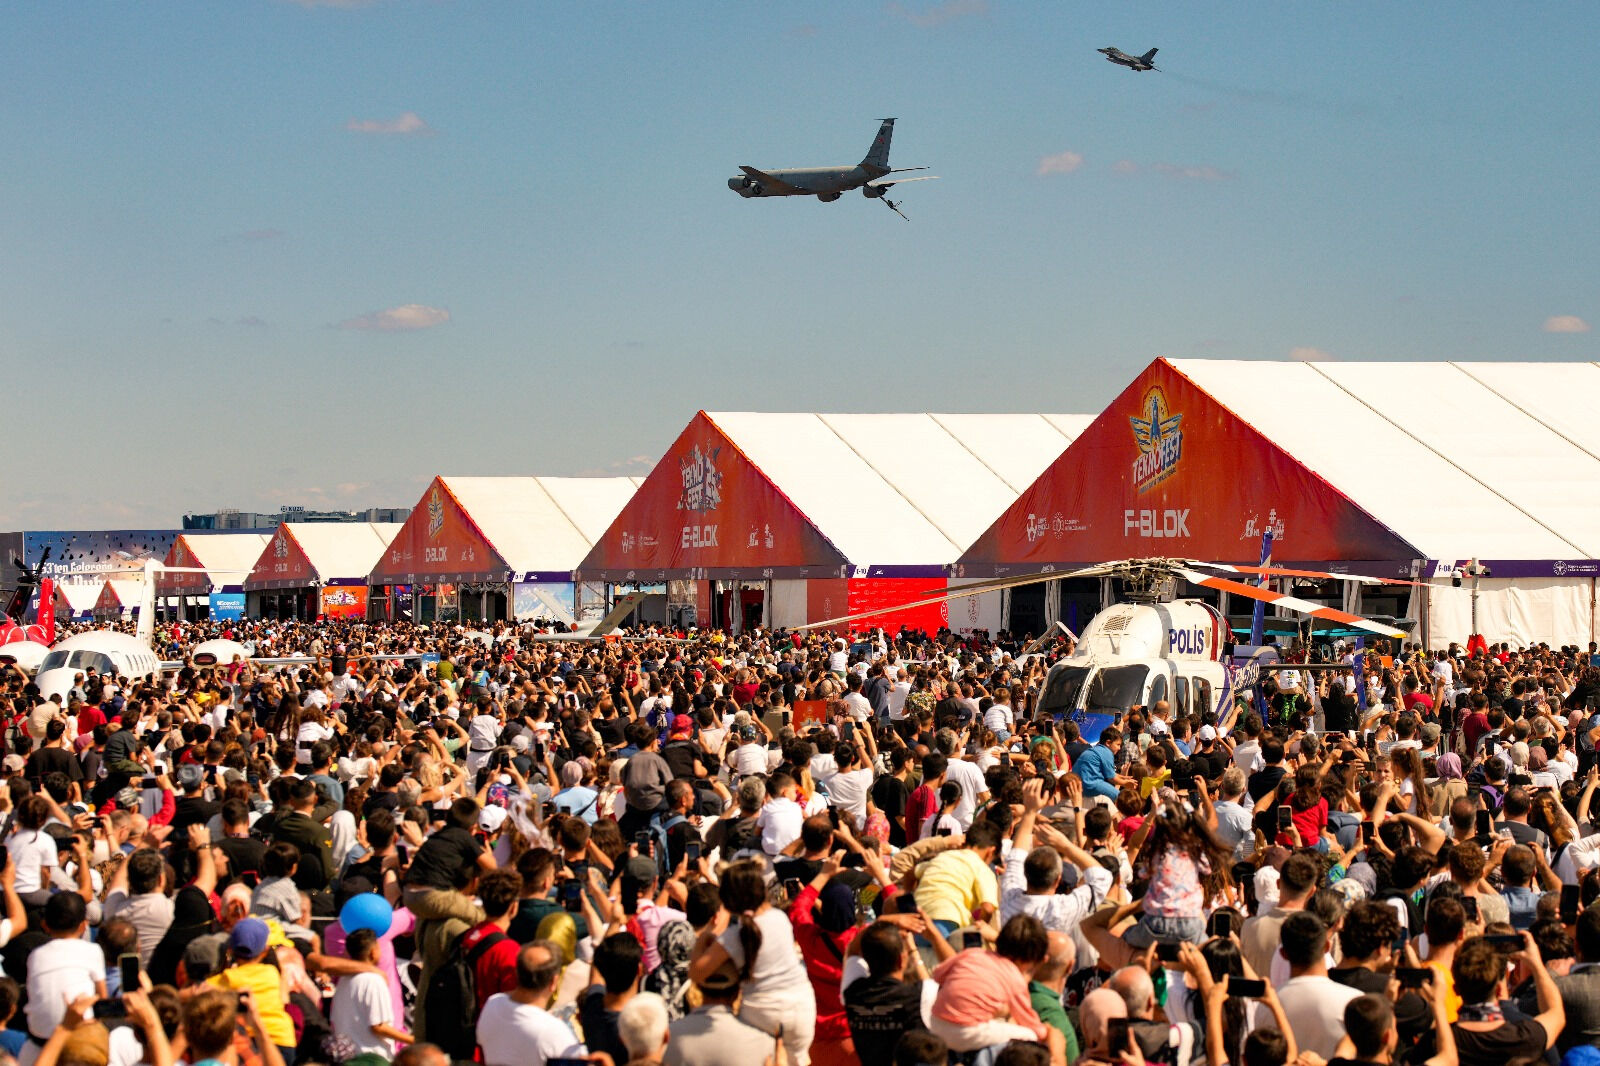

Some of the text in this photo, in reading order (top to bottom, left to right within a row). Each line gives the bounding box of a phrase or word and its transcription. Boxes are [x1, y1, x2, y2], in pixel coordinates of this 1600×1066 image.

[682, 525, 718, 548] E-BLOK
[1124, 509, 1191, 538] F-BLOK
[1168, 624, 1205, 655] POLİS
